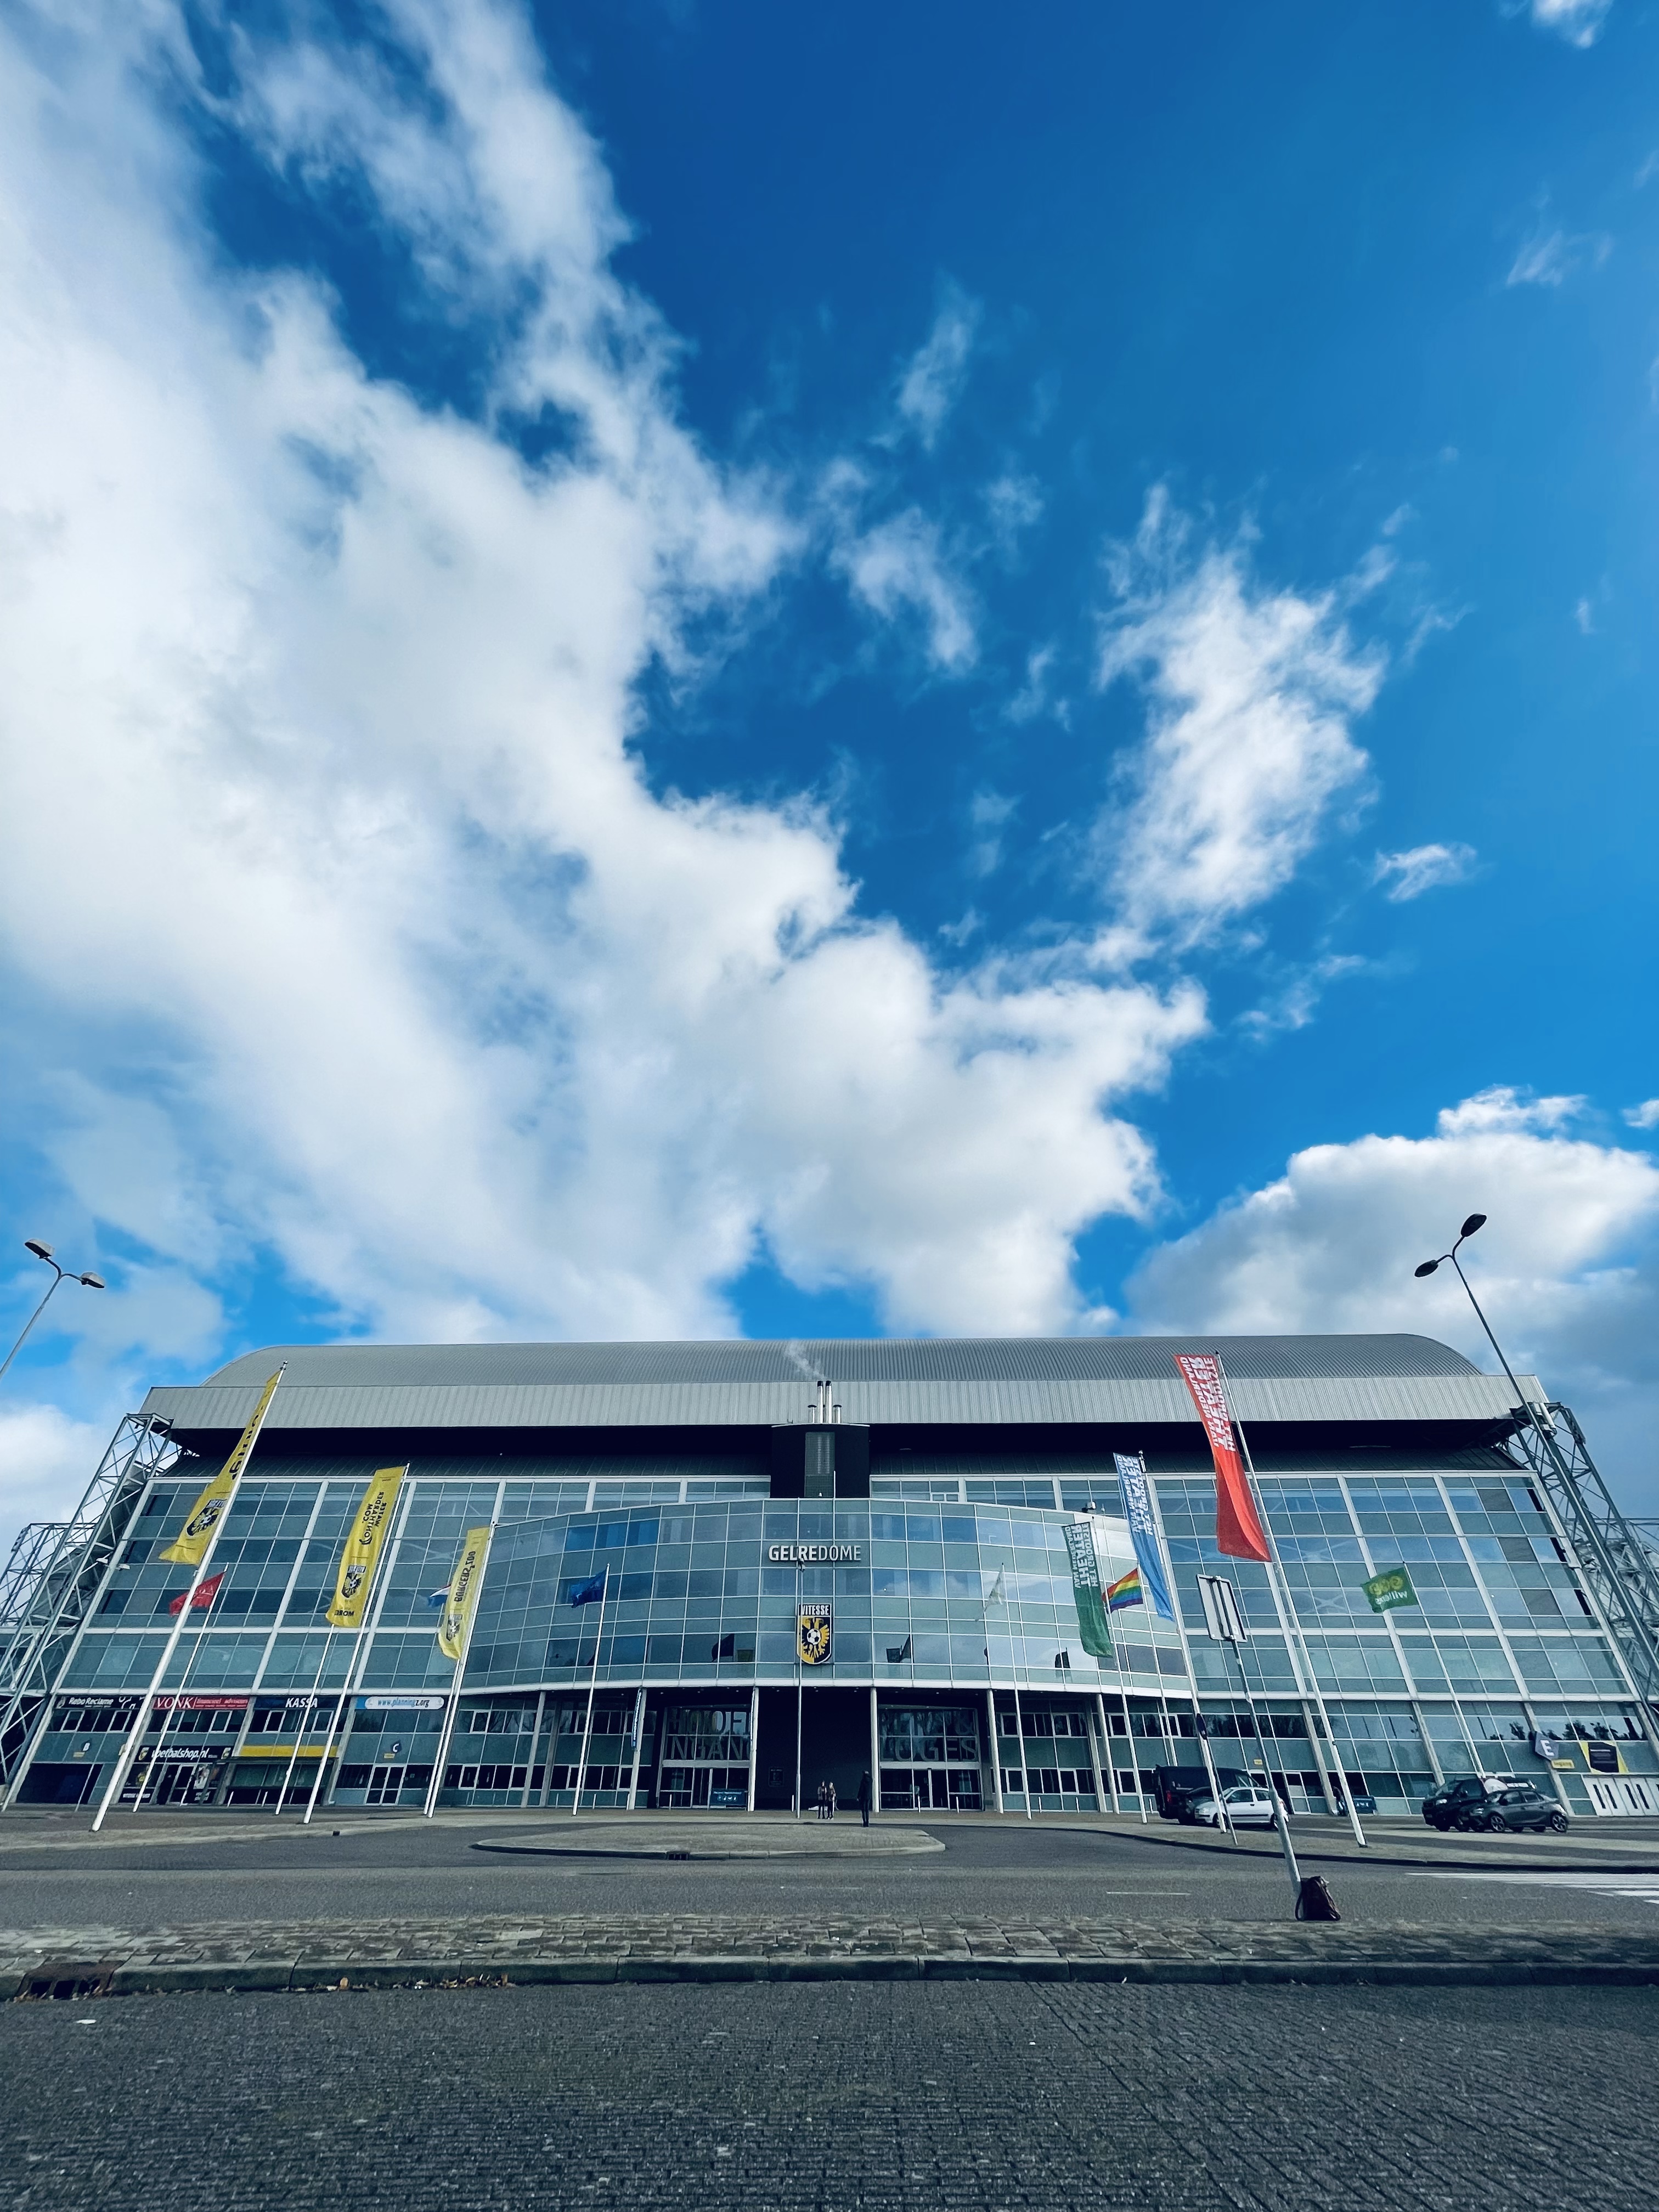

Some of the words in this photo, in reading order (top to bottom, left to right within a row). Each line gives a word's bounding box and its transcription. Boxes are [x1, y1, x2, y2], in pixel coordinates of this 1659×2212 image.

[768, 1544, 861, 1561] GELREDOME
[800, 1604, 829, 1616] VITESSE
[157, 1696, 194, 1709] VONK
[285, 1697, 318, 1708] KASSA
[392, 1743, 400, 1753] C
[664, 1735, 751, 1760] INGAN
[1539, 1740, 1555, 1756] E
